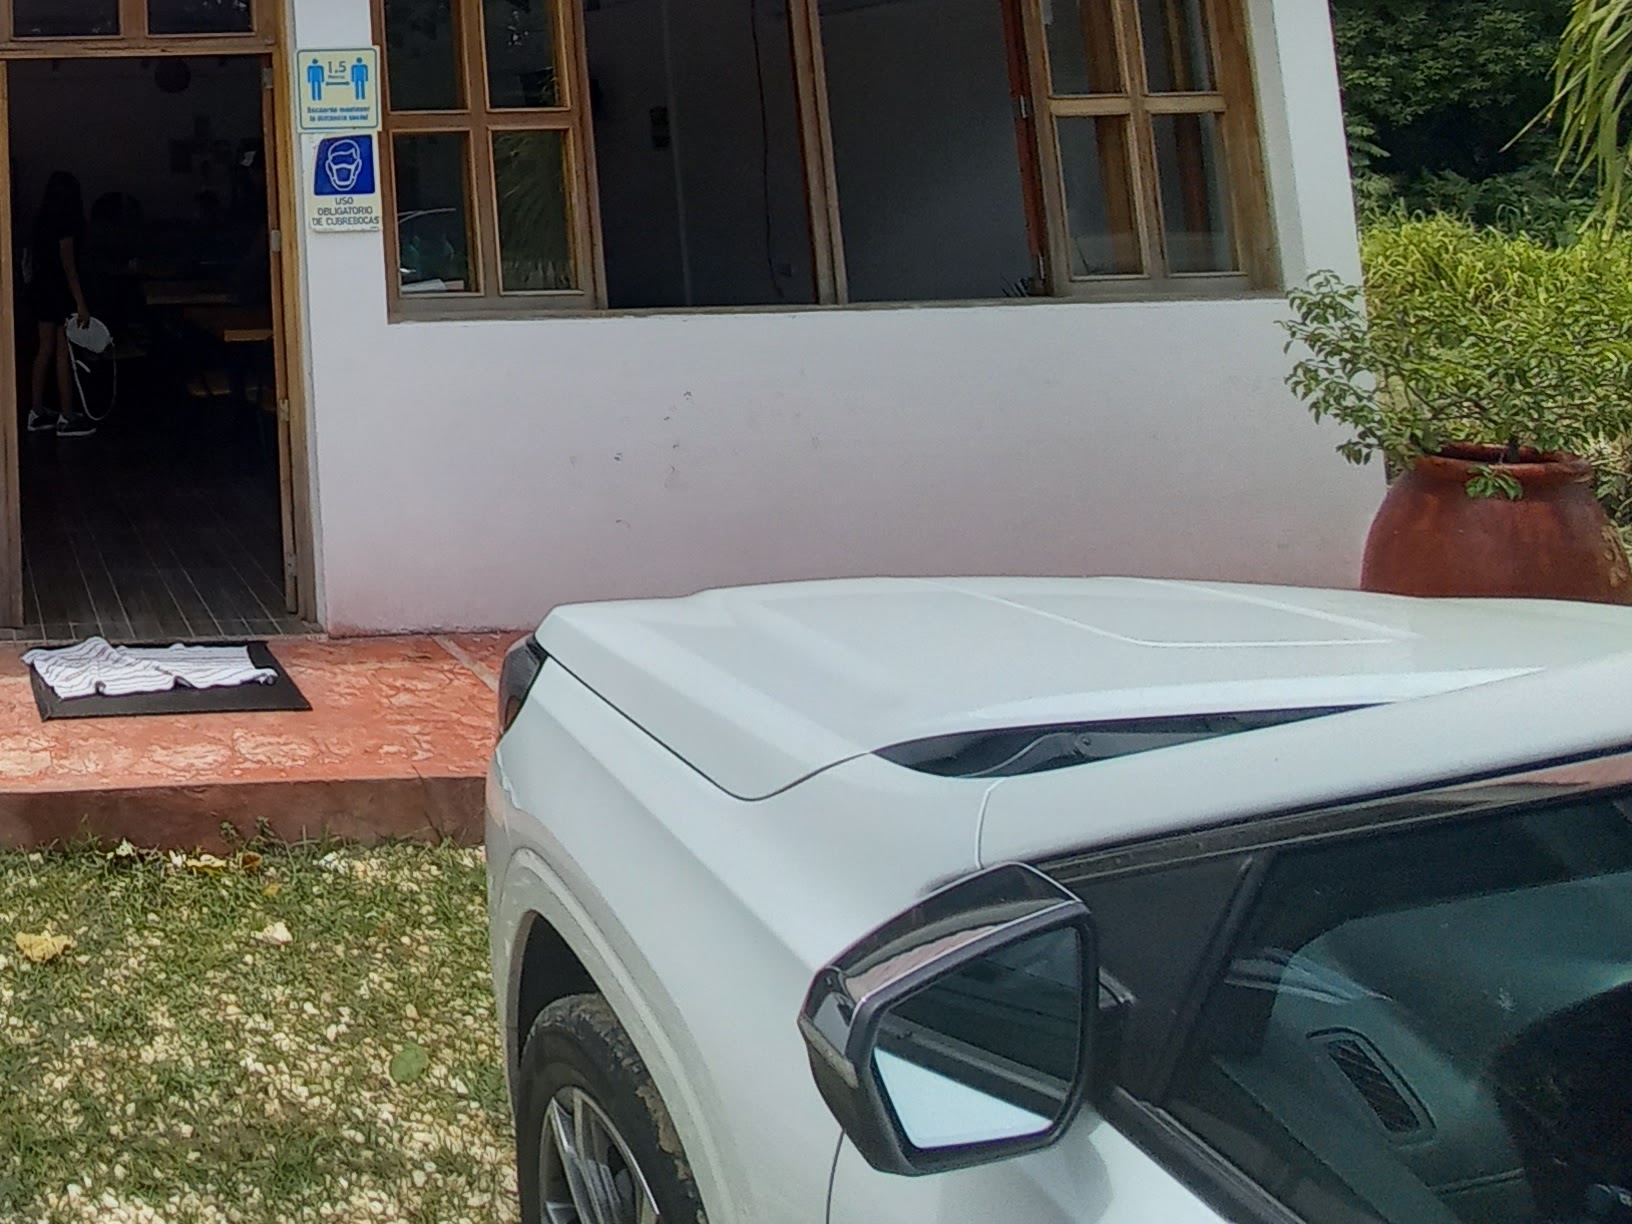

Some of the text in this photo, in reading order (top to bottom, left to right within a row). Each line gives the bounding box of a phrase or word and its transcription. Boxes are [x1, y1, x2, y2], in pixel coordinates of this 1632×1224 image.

[328, 61, 347, 74] 1.5
[335, 196, 354, 205] USO
[317, 206, 373, 216] OBLIGATORIO
[312, 216, 380, 226] DE CUBREBOCAS
